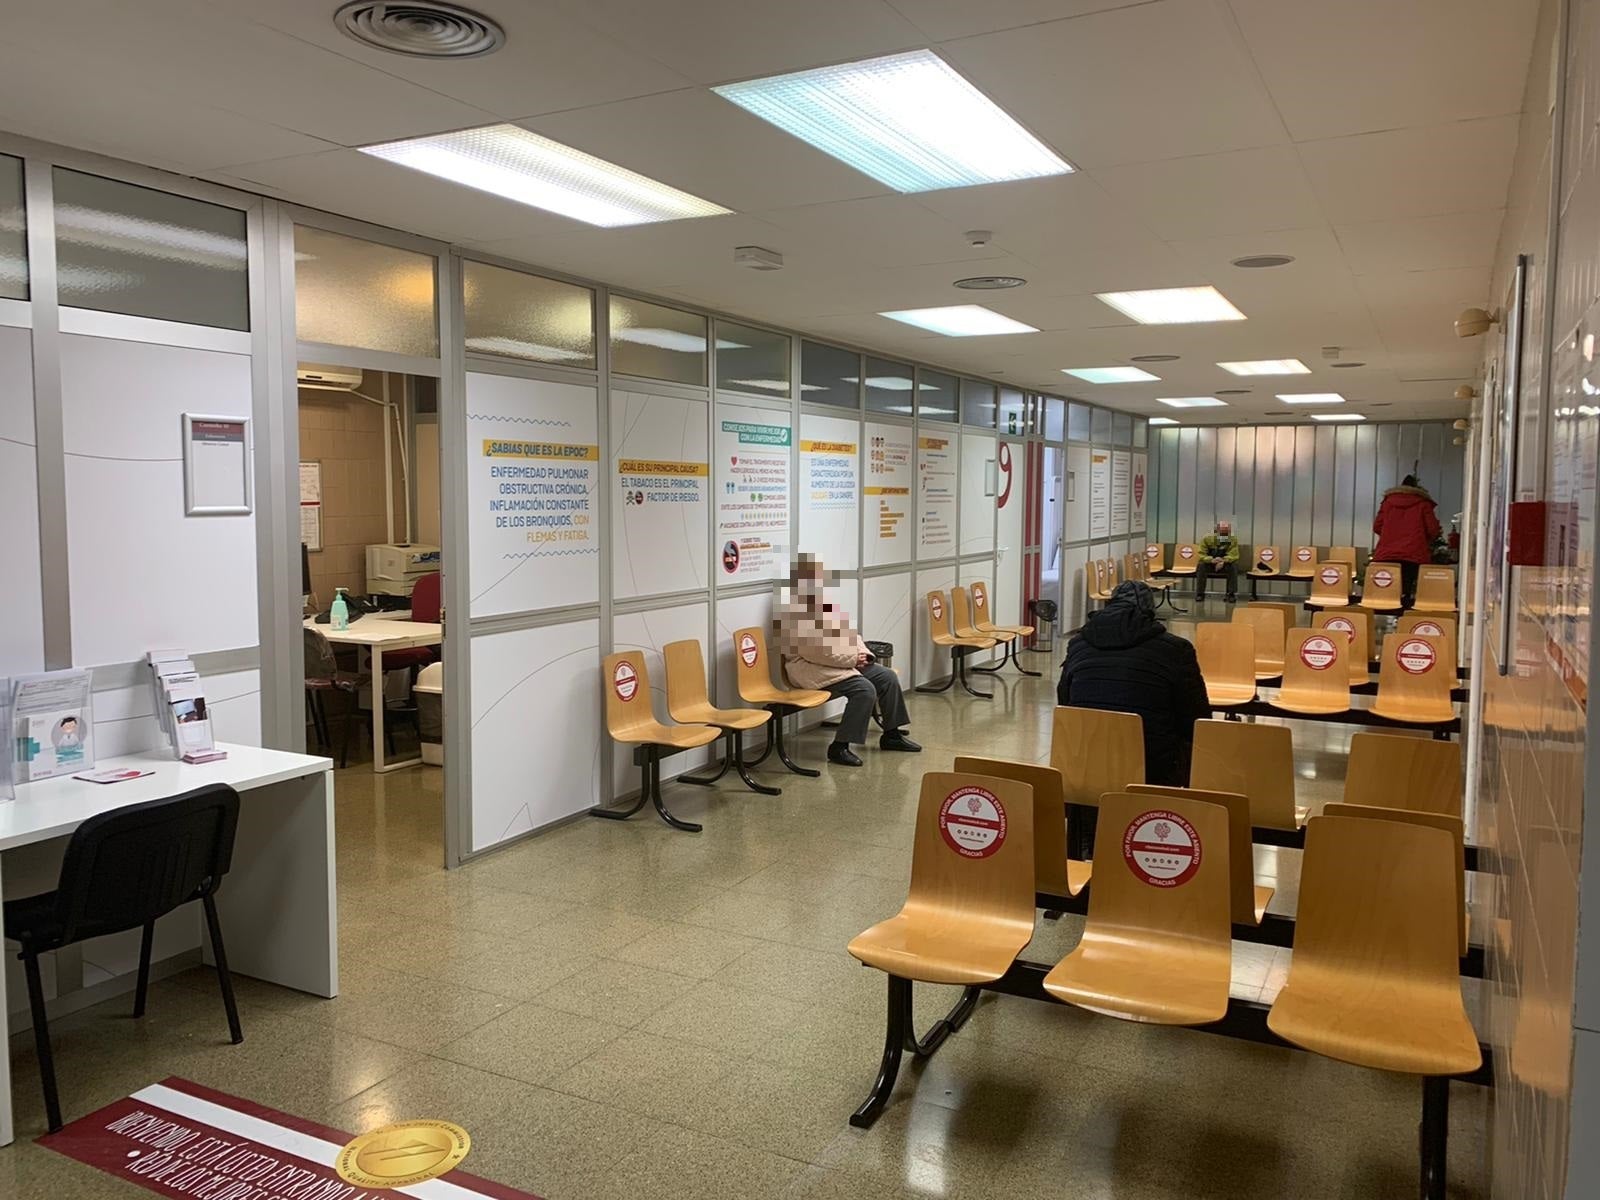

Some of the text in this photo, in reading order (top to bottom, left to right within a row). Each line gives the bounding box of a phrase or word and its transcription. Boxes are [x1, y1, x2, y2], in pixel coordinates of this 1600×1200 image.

[523, 444, 540, 457] QUE
[541, 444, 553, 456] ES
[553, 446, 564, 456] LA
[564, 446, 589, 458] EPOC?
[490, 465, 589, 479] ENFERMEDAD PULMONAR
[637, 463, 644, 472] ES
[645, 463, 652, 472] SU
[653, 463, 680, 473] PRINCIPAL
[680, 464, 699, 473] CAUSA?
[997, 441, 1012, 509] 9
[499, 482, 554, 495] OBSTRUCTIVA
[621, 477, 699, 489] EL TABACO ES EL PRINCIPAL
[489, 497, 589, 511] INFLAMACIÓN CONSTANTE
[647, 492, 670, 502] FACTOR
[670, 492, 678, 502] DE
[496, 516, 508, 528] DE
[509, 515, 525, 528] LOS
[573, 514, 590, 525] CON
[526, 530, 557, 543] FLEMAS
[558, 531, 564, 541] Y
[1183, 823, 1197, 839] ESTE
[147, 1159, 191, 1182] DE
[213, 1149, 280, 1182] USTED
[164, 1165, 213, 1191] LOS
